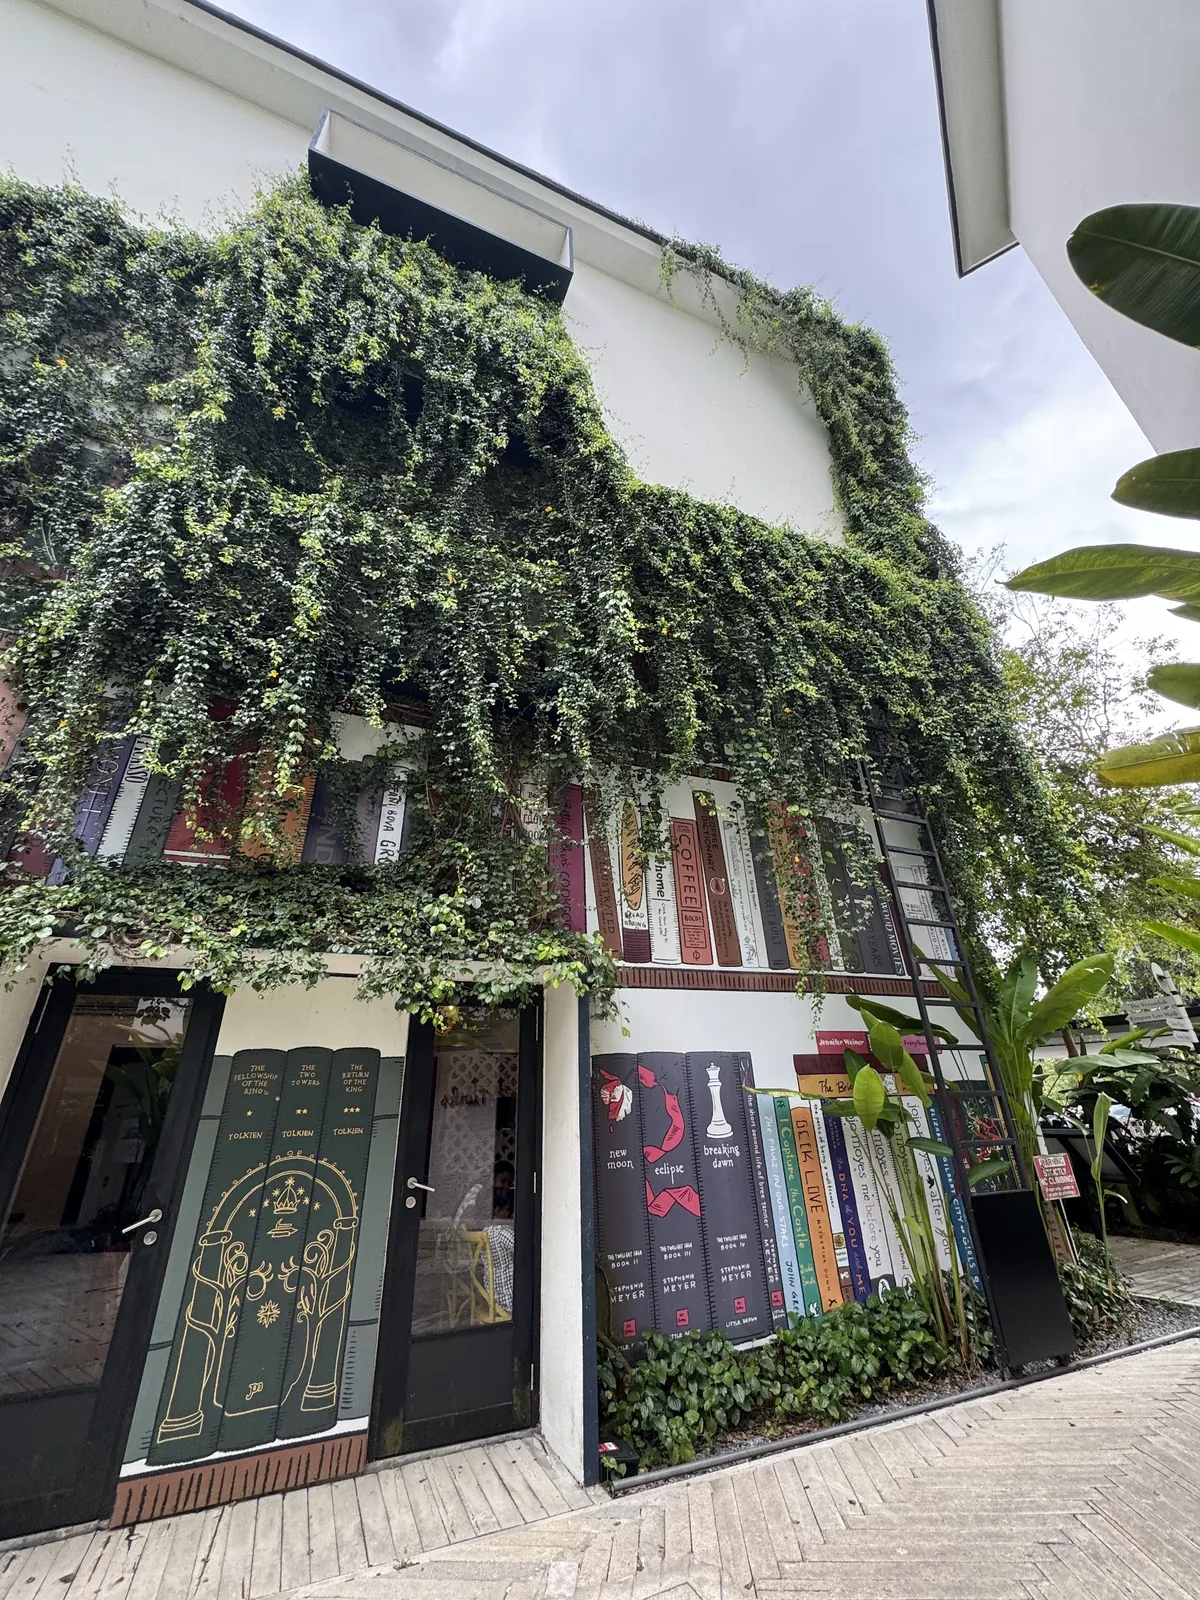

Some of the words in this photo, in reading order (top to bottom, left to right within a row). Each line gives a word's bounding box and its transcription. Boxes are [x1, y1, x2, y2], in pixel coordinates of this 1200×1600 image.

[383, 810, 398, 832] BOVA
[700, 814, 716, 872] DICTIONARY
[678, 833, 698, 905] COFFEE
[654, 864, 667, 898] home
[767, 920, 781, 945] BUILT
[867, 936, 881, 967] YEARS
[887, 934, 904, 975] MOVIES
[818, 1038, 843, 1046] Jennifer
[843, 1038, 865, 1046] Weiner
[233, 1072, 279, 1082] FELLOWSHIP
[250, 1064, 266, 1072] THE
[299, 1071, 316, 1079] TWO
[342, 1071, 369, 1079] RETURN
[343, 1078, 352, 1086] OF
[353, 1078, 367, 1086] THE
[818, 1078, 834, 1093] The
[228, 1131, 263, 1141] TOLKIEN
[282, 1129, 314, 1138] TOLKIEN
[333, 1127, 364, 1136] TOLKIEN
[703, 1143, 740, 1157] breaking
[751, 1129, 760, 1155] second
[795, 1120, 814, 1163] GEEK
[609, 1148, 627, 1159] new
[768, 1138, 778, 1168] FAULT
[781, 1126, 795, 1181] Capture
[814, 1116, 822, 1135] perks
[820, 1145, 828, 1164] being
[825, 1171, 835, 1208] wallflower
[851, 1134, 867, 1179] moyes
[873, 1132, 889, 1177] moyes
[895, 1132, 910, 1175] moyes
[1040, 1157, 1065, 1166] WARNING
[607, 1160, 634, 1170] moon
[712, 1158, 734, 1169] dawn
[755, 1156, 763, 1169] life
[654, 1162, 685, 1185] eclipse
[757, 1170, 764, 1180] of
[773, 1174, 782, 1188] IN
[1043, 1167, 1067, 1177] STRICTLY
[1049, 1175, 1074, 1185] CLIMBING
[758, 1181, 766, 1199] bree
[790, 1187, 800, 1203] the
[804, 1170, 824, 1213] LOVE
[861, 1183, 871, 1202] me
[942, 1156, 957, 1195] GILBERT
[952, 1198, 966, 1223] CITY
[775, 1190, 785, 1213] OUR
[760, 1201, 769, 1228] tanner
[865, 1204, 879, 1242] before
[779, 1214, 789, 1248] STARS
[793, 1205, 809, 1249] Castle
[838, 1172, 850, 1201] DNA
[847, 1216, 859, 1248] YOU
[855, 1273, 867, 1295] ME
[663, 1252, 681, 1260] BOOK
[720, 1243, 737, 1251] BOOK
[816, 1219, 827, 1264] KATHERINE
[823, 1268, 831, 1291] DUNN
[869, 1244, 882, 1267] you
[611, 1261, 630, 1269] BOOK
[720, 1263, 750, 1274] STEPHENIE
[763, 1239, 774, 1283] MEYER
[769, 1238, 779, 1282] STEPHENIE
[662, 1273, 695, 1284] STEPHENIE
[721, 1270, 752, 1283] MEYER
[785, 1260, 795, 1288] JOHN
[610, 1281, 644, 1293] TEPHENIE
[663, 1280, 696, 1294] MEYER
